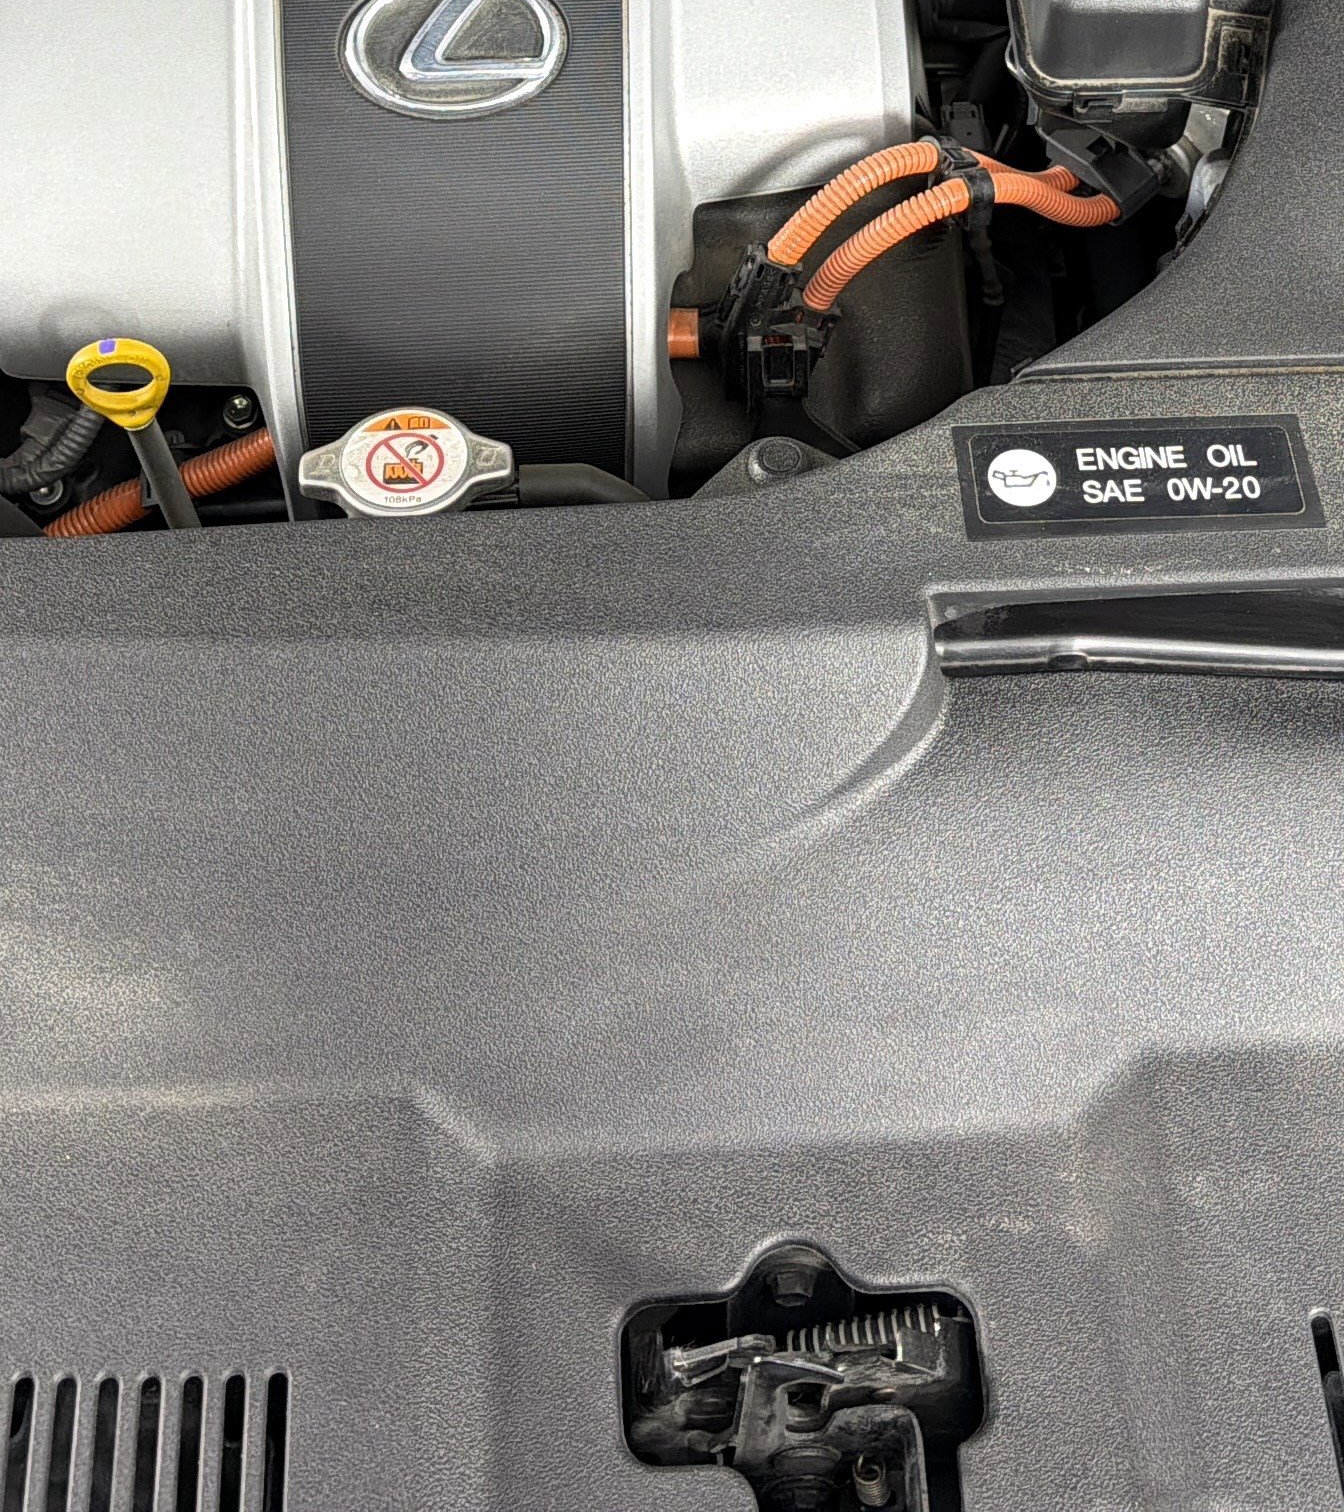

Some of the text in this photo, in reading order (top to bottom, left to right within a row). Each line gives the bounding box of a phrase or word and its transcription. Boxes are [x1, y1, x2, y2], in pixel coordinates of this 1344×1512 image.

[1075, 443, 1259, 472] ENGINE OIL
[1082, 475, 1262, 504] SAE 0W-20
